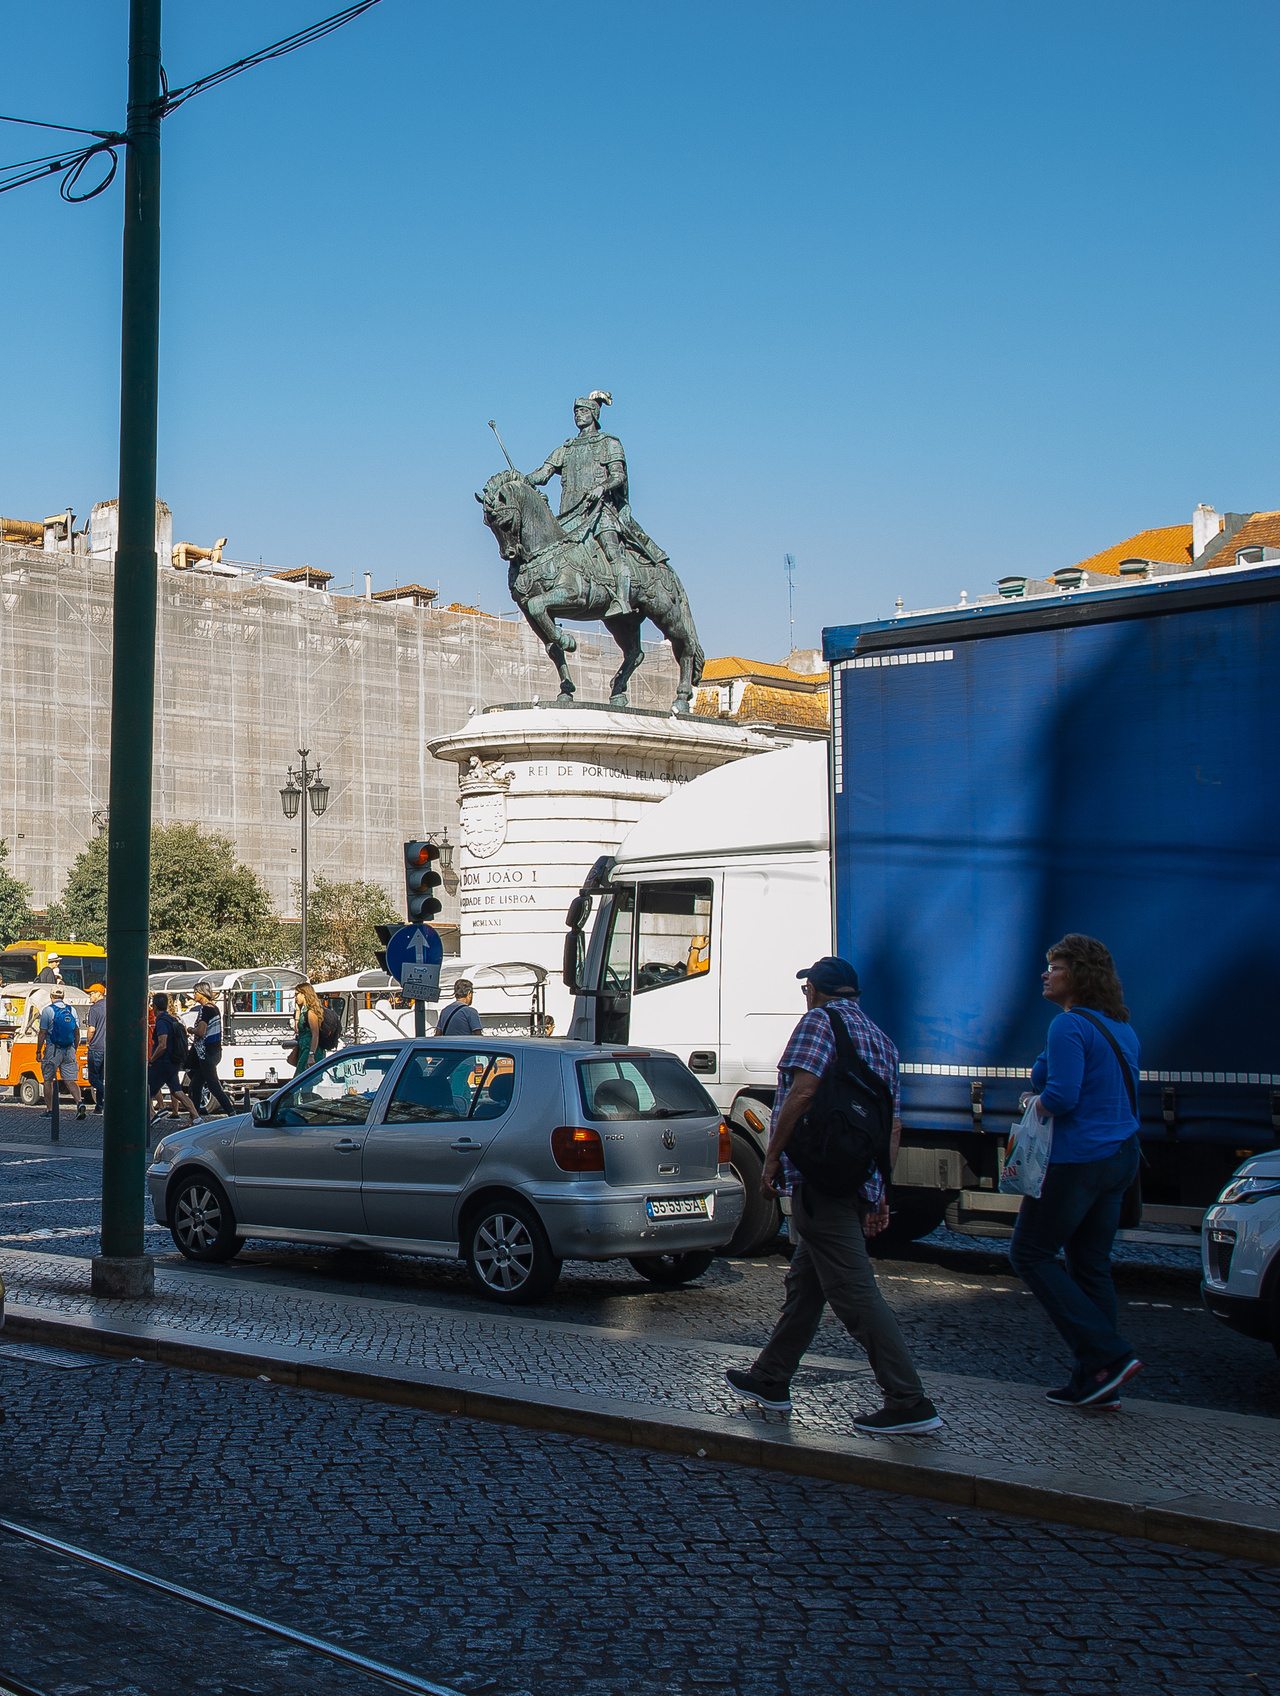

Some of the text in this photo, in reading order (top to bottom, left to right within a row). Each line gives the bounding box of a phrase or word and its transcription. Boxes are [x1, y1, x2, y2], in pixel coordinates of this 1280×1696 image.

[528, 765, 549, 777] REI
[557, 765, 574, 777] DE
[582, 765, 631, 780] PORTUGAL
[635, 769, 655, 782] PELA
[486, 869, 523, 884] JOÃO
[531, 870, 538, 883] I
[485, 895, 496, 905] DE
[499, 894, 537, 905] LISBOA
[604, 1132, 625, 1141] POLO
